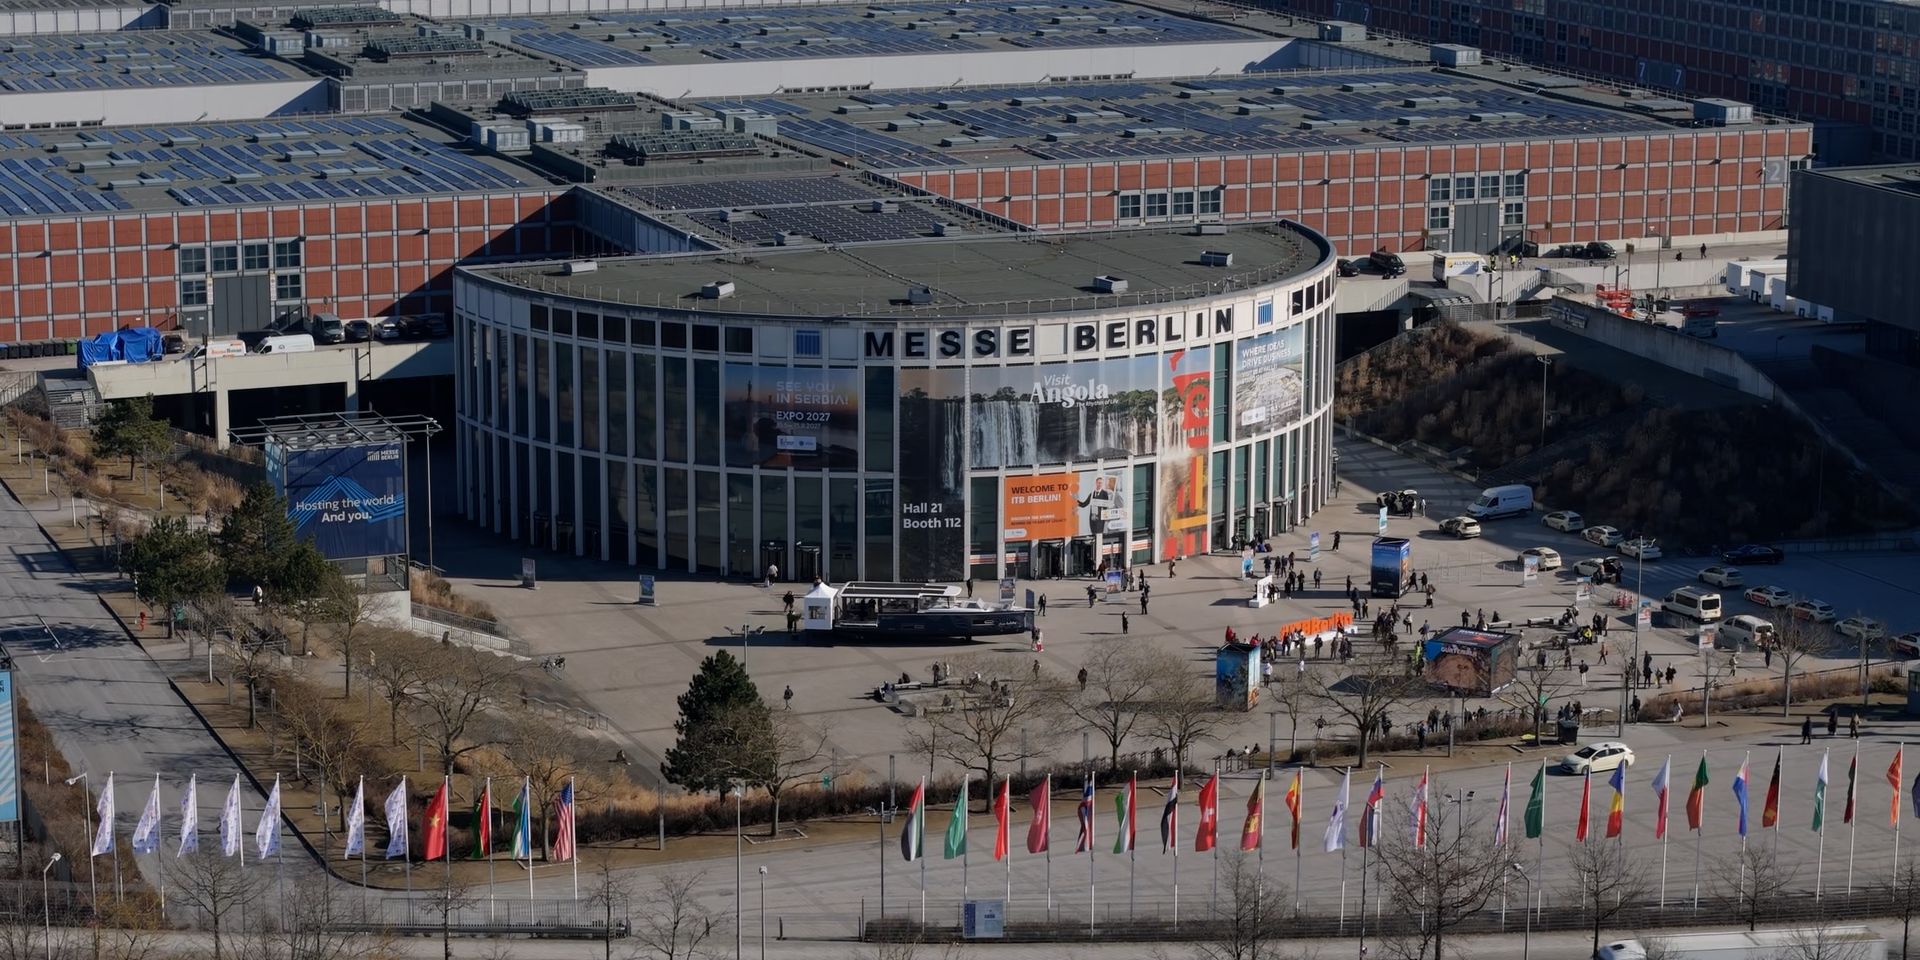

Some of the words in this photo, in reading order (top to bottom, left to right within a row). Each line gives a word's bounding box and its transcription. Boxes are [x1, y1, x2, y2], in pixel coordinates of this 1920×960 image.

[1639, 62, 1646, 78] 7
[1675, 69, 1682, 85] 7
[1769, 162, 1781, 181] 2
[864, 328, 1031, 357] MESSE
[1075, 307, 1232, 350] BERLIN
[1242, 344, 1267, 358] WHERE
[1267, 339, 1285, 352] IDEAS
[1242, 356, 1262, 369] DRIVE
[1043, 373, 1072, 386] Visit
[776, 380, 801, 392] SEE
[806, 382, 835, 393] YOU
[1029, 377, 1109, 408] Angola
[776, 392, 790, 403] IN
[795, 394, 849, 405] SERBIA!
[776, 411, 804, 421] EXPO
[806, 412, 831, 422] 2027
[1011, 484, 1055, 494] WELCOME
[1058, 483, 1069, 491] TO
[296, 500, 339, 511] Hosting
[341, 498, 360, 508] the
[362, 494, 397, 506] world.
[1011, 496, 1025, 504] ITB
[1027, 494, 1061, 503] BERLIN!
[903, 502, 928, 513] Hall
[930, 502, 942, 513] 21
[321, 511, 346, 523] And
[347, 511, 373, 523] you.
[903, 517, 942, 528] Booth
[944, 517, 962, 528] 112
